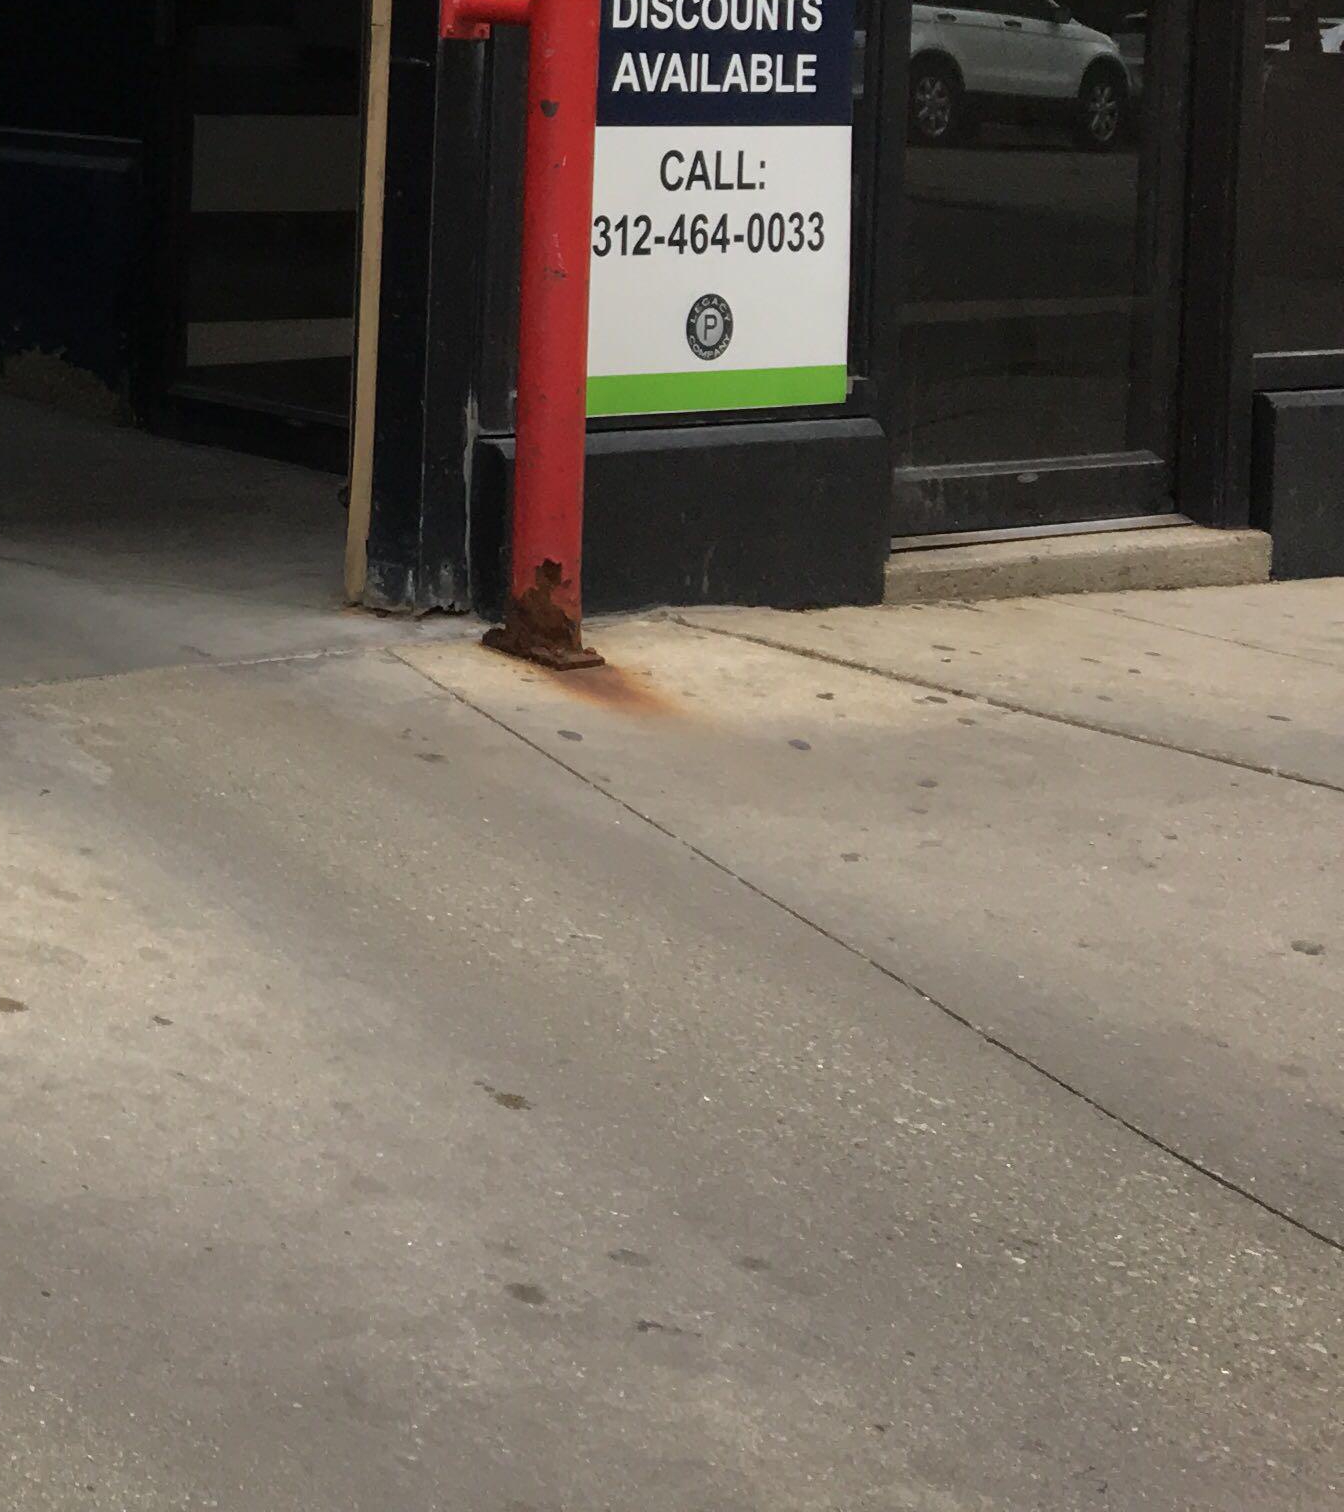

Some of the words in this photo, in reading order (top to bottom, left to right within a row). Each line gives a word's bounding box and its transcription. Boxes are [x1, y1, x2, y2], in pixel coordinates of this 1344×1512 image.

[612, 52, 817, 93] AVAILABLE
[659, 149, 767, 192] CALL:
[592, 211, 825, 257] 312-464-0033
